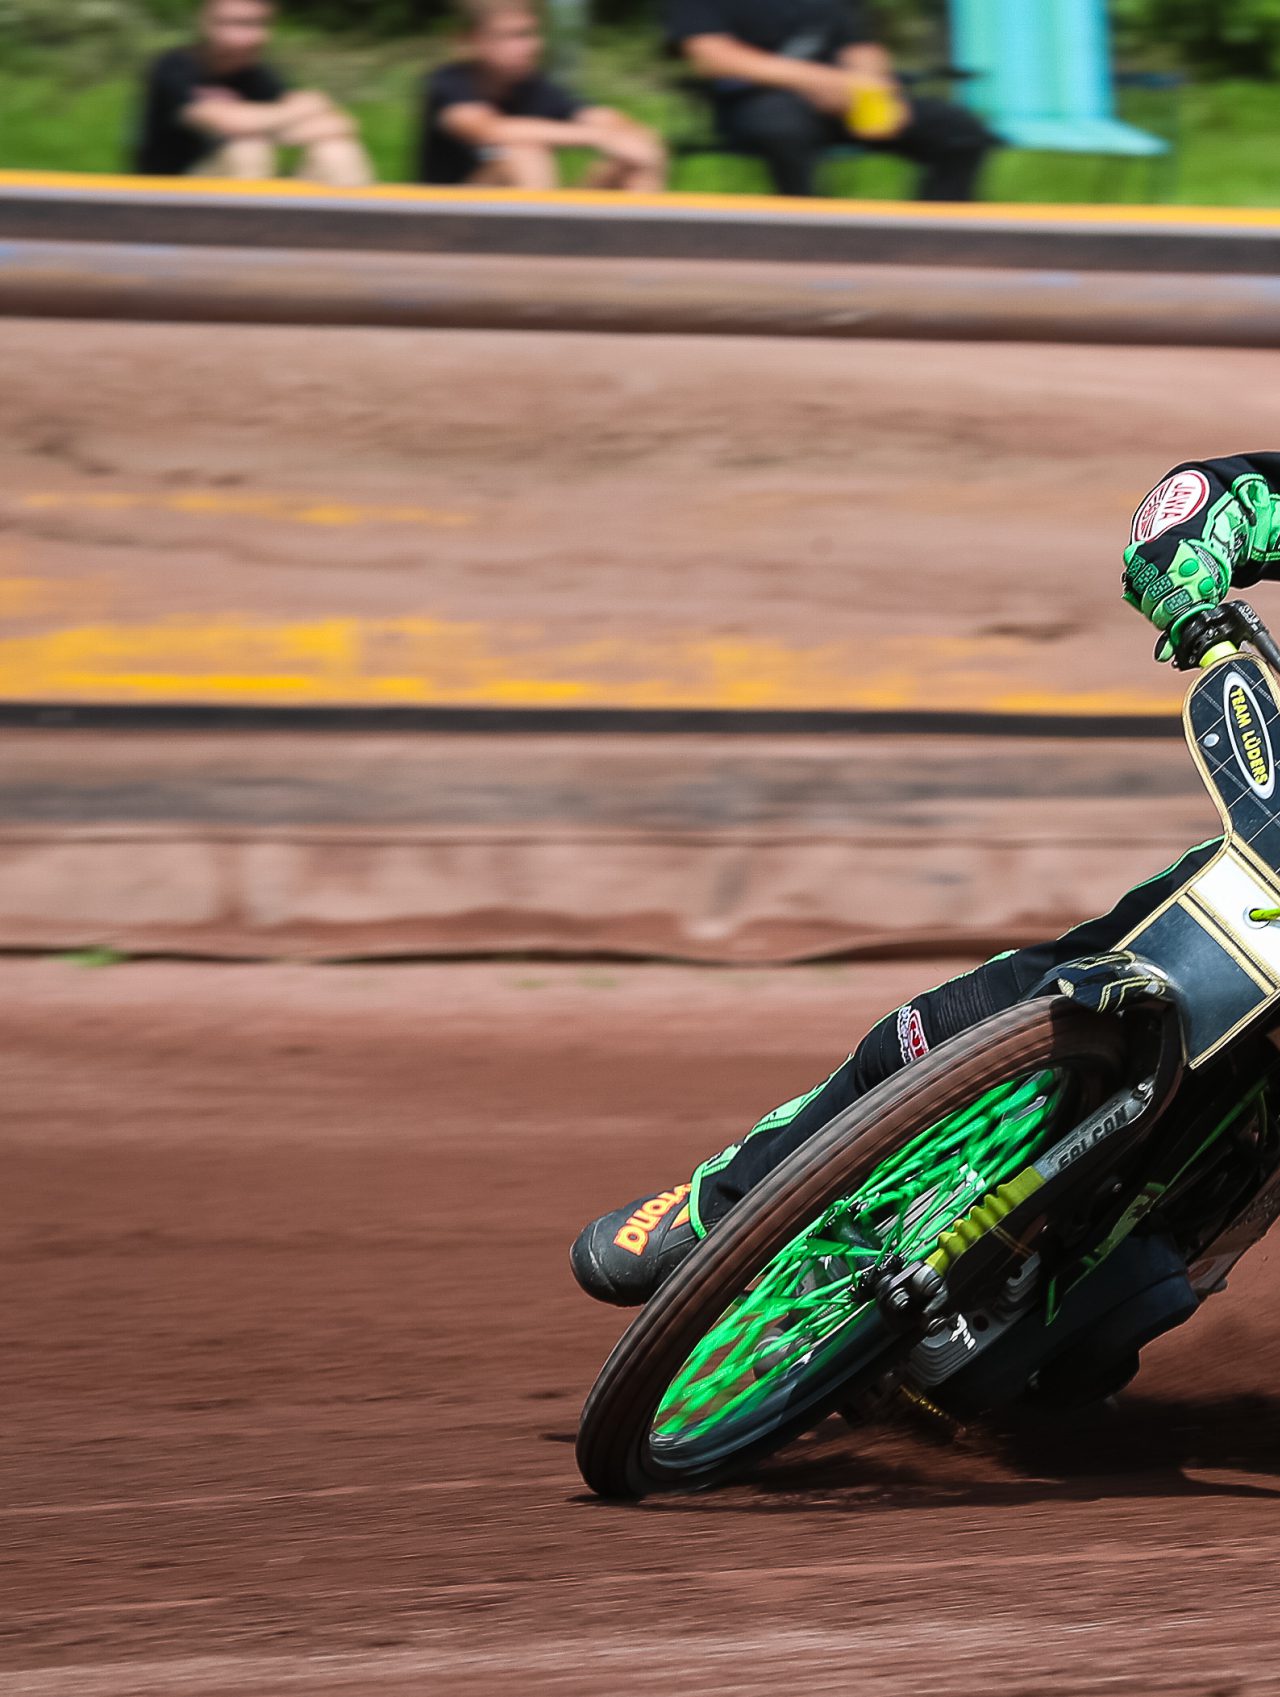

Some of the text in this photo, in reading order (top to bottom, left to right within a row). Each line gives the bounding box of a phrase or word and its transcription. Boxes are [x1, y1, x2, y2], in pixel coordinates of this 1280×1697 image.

[1159, 482, 1196, 521] JAWA
[1229, 687, 1268, 785] TEAM LÜDERS
